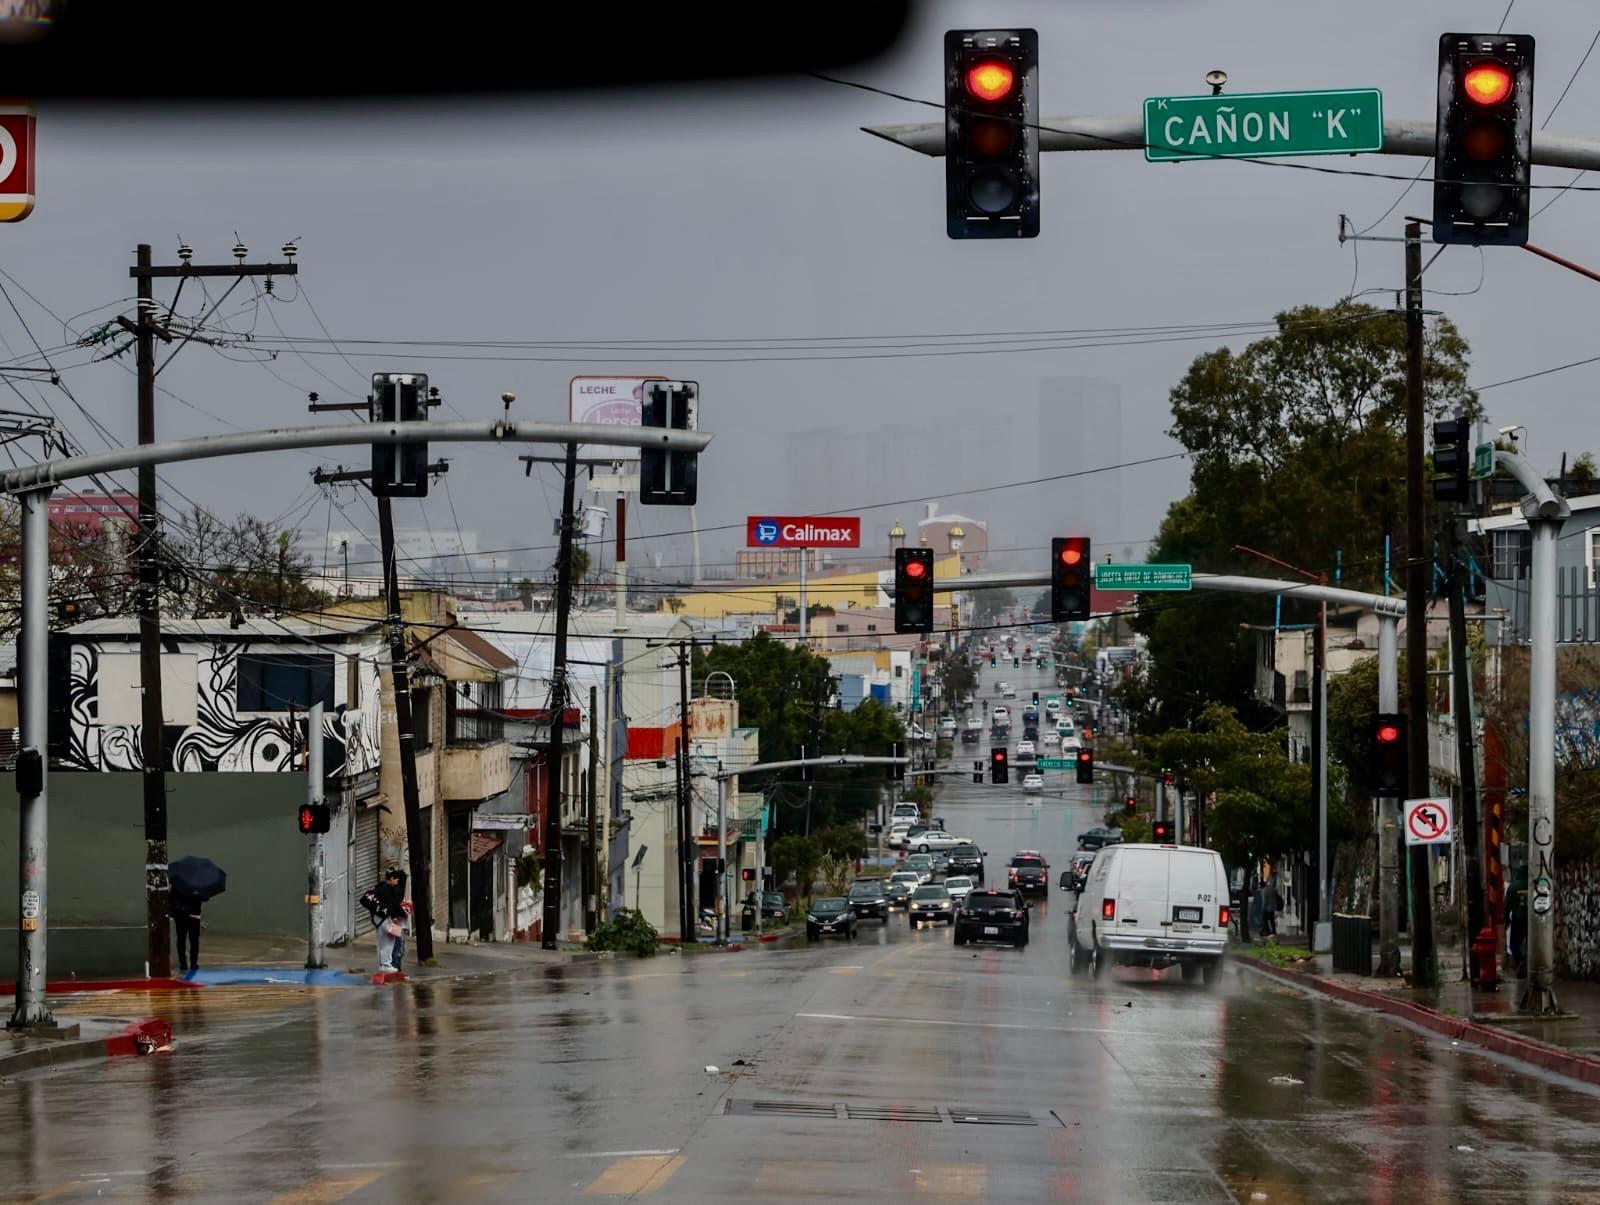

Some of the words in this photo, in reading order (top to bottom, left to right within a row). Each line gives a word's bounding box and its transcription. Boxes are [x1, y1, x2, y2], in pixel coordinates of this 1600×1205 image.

[1157, 99, 1168, 110] K
[1164, 106, 1290, 146] CAÑON
[579, 386, 616, 395] LECHE
[782, 523, 851, 541] Calimax
[1197, 894, 1211, 903] P-02
